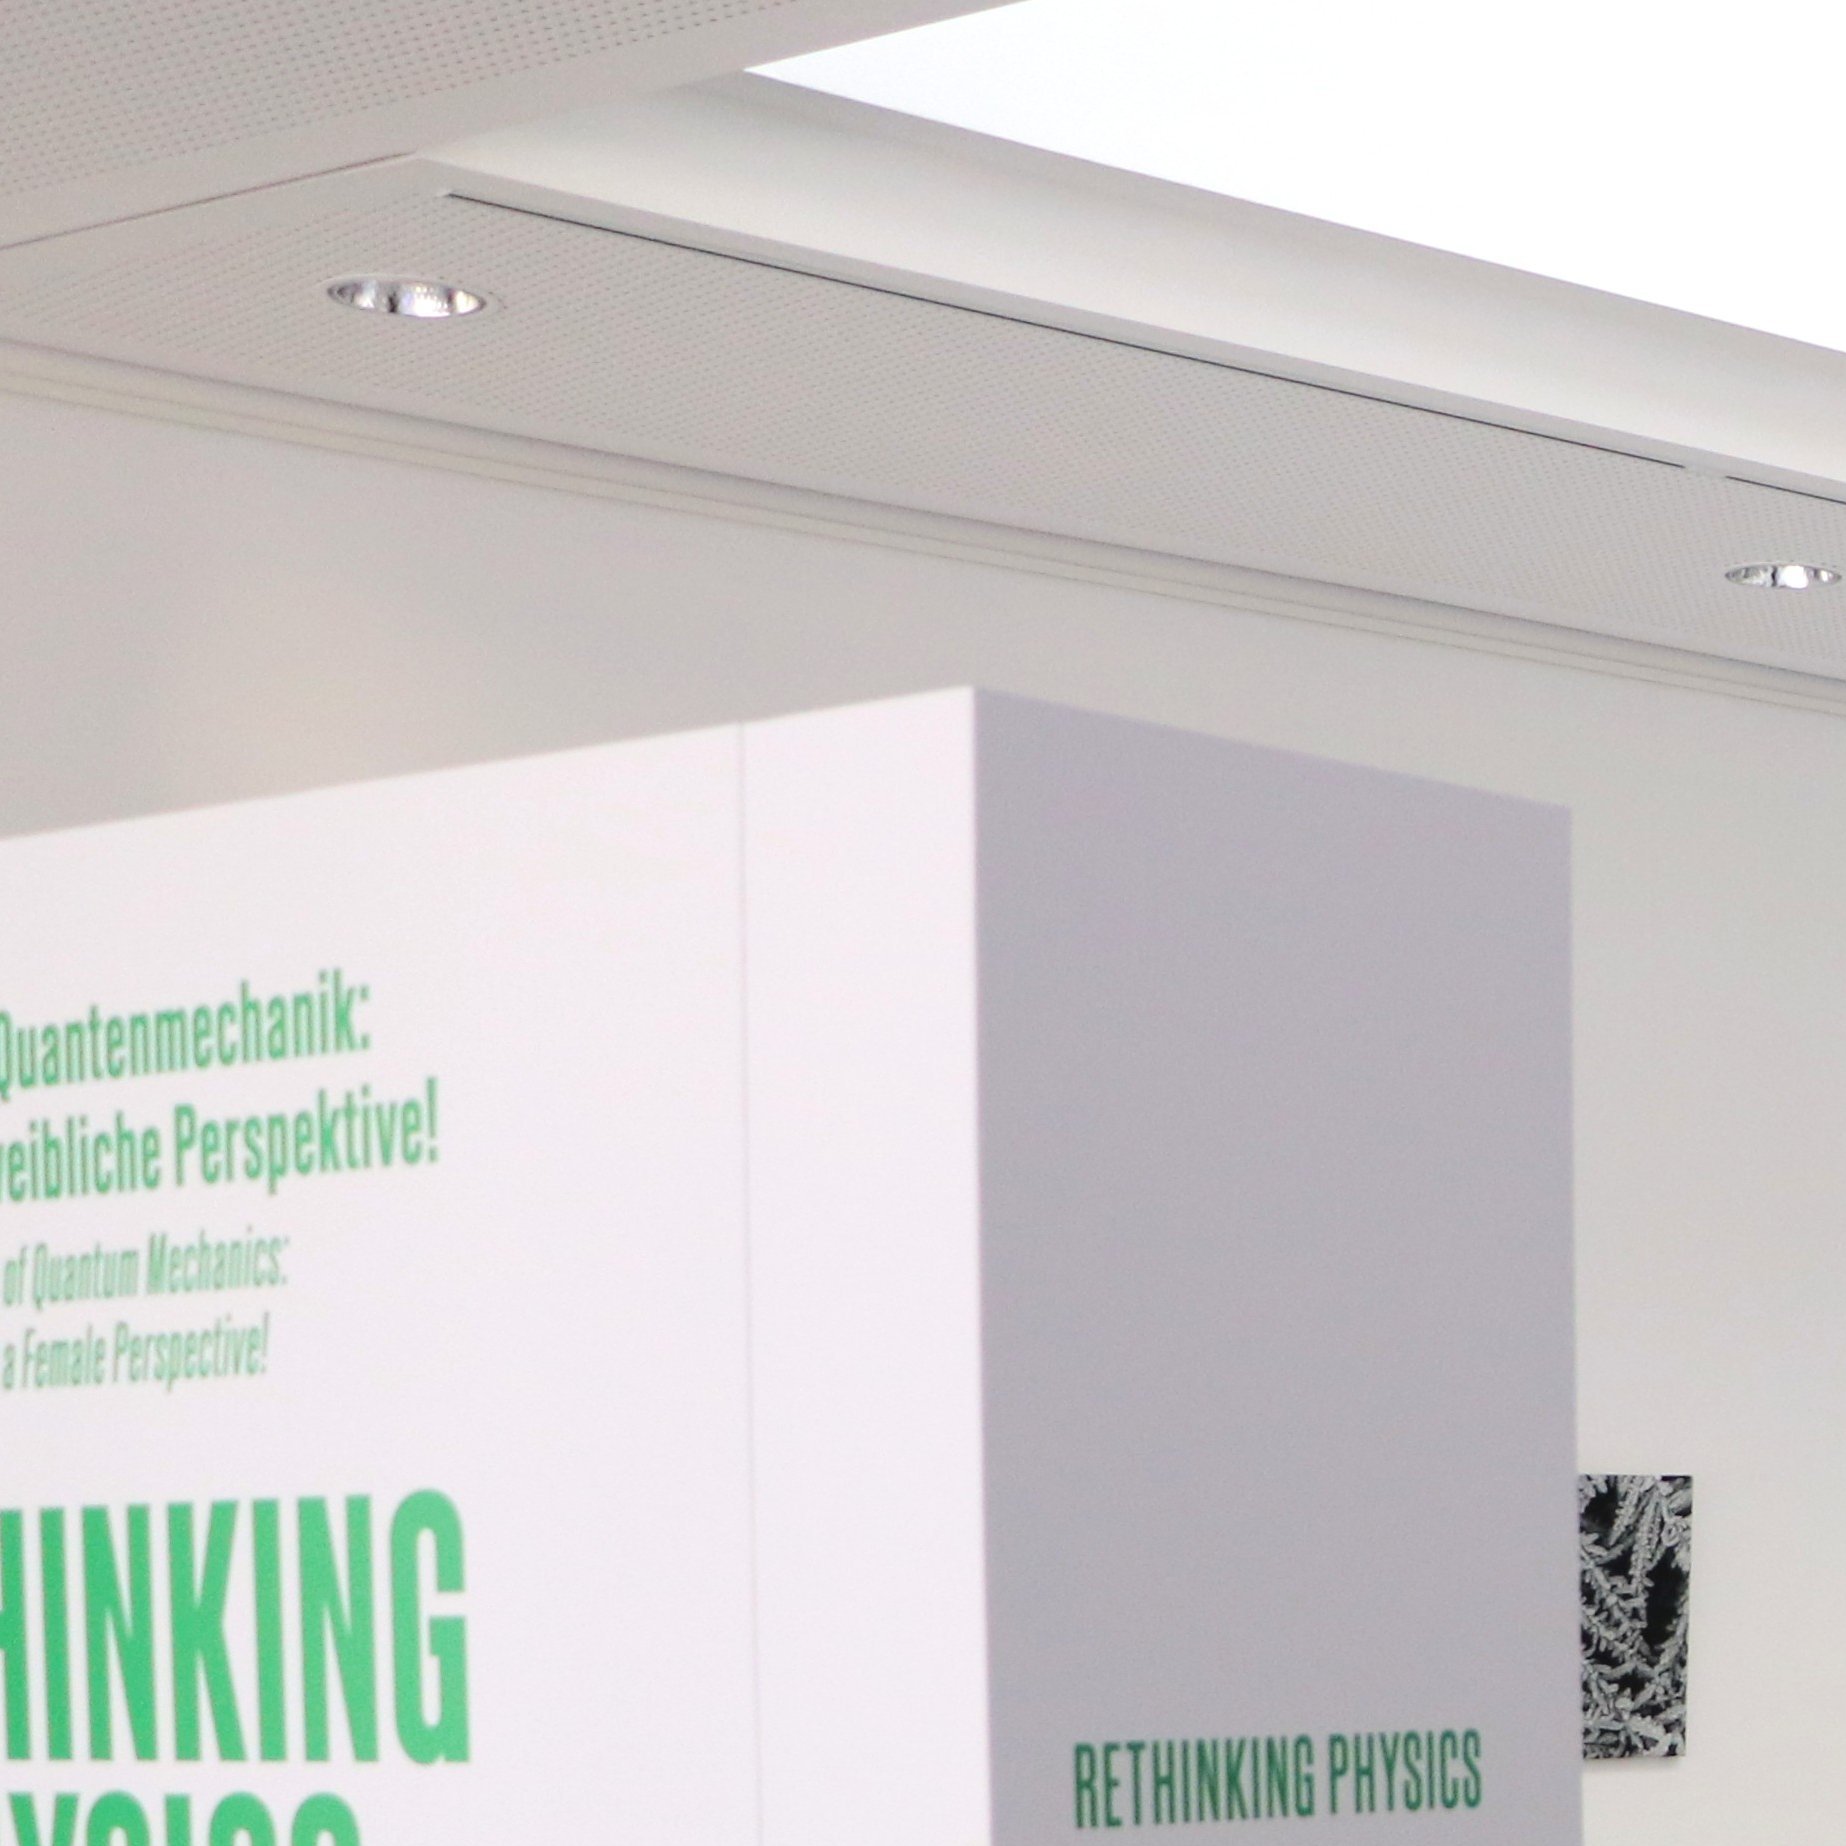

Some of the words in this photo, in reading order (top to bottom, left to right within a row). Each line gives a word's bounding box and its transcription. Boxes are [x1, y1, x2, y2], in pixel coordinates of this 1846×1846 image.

[174, 1076, 438, 1195] Perspektive!
[32, 1242, 138, 1310] Quantum
[146, 1227, 289, 1295] Mechanics:
[22, 1324, 105, 1387] Female
[113, 1311, 271, 1391] Perspective!
[1075, 1735, 1315, 1829] RETHINKING
[1328, 1728, 1483, 1815] PHYSICS
